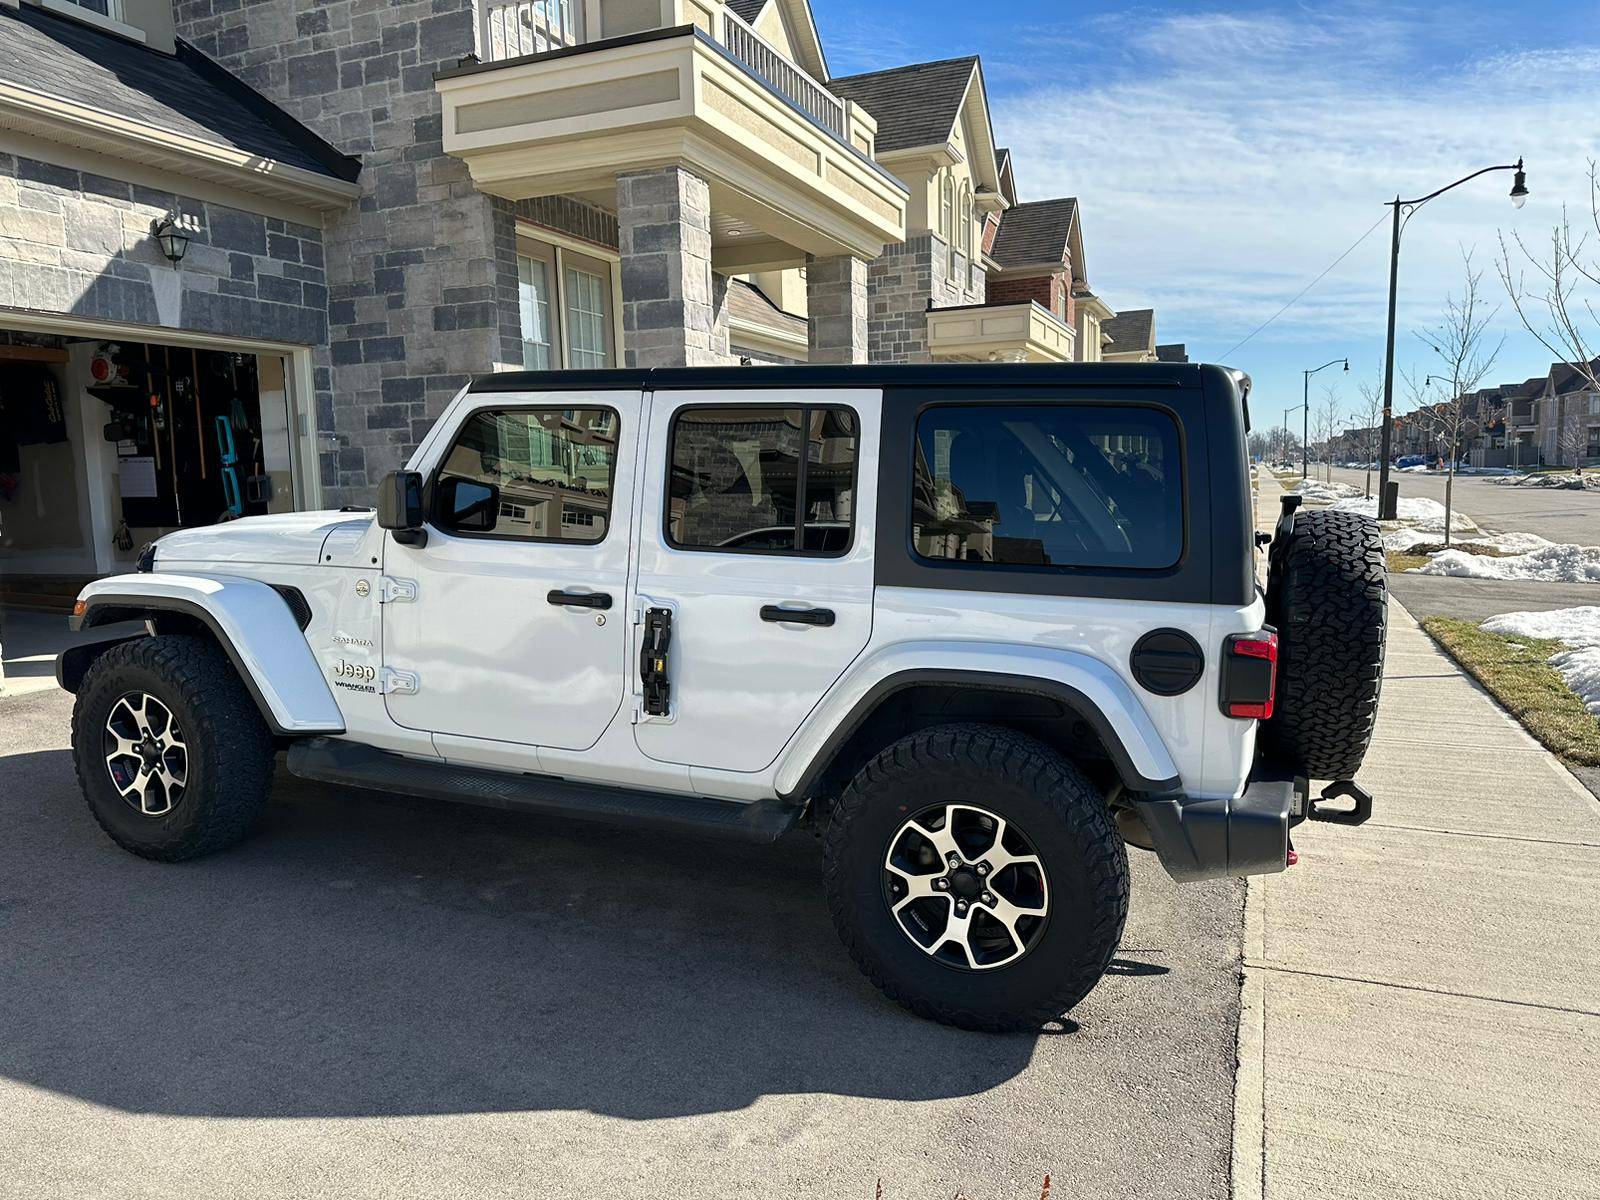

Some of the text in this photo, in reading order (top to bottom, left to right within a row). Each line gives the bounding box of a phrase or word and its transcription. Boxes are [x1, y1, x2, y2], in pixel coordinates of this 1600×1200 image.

[332, 636, 374, 647] SAHARA
[333, 659, 376, 683] Jeep
[334, 681, 375, 691] WRANGLER
